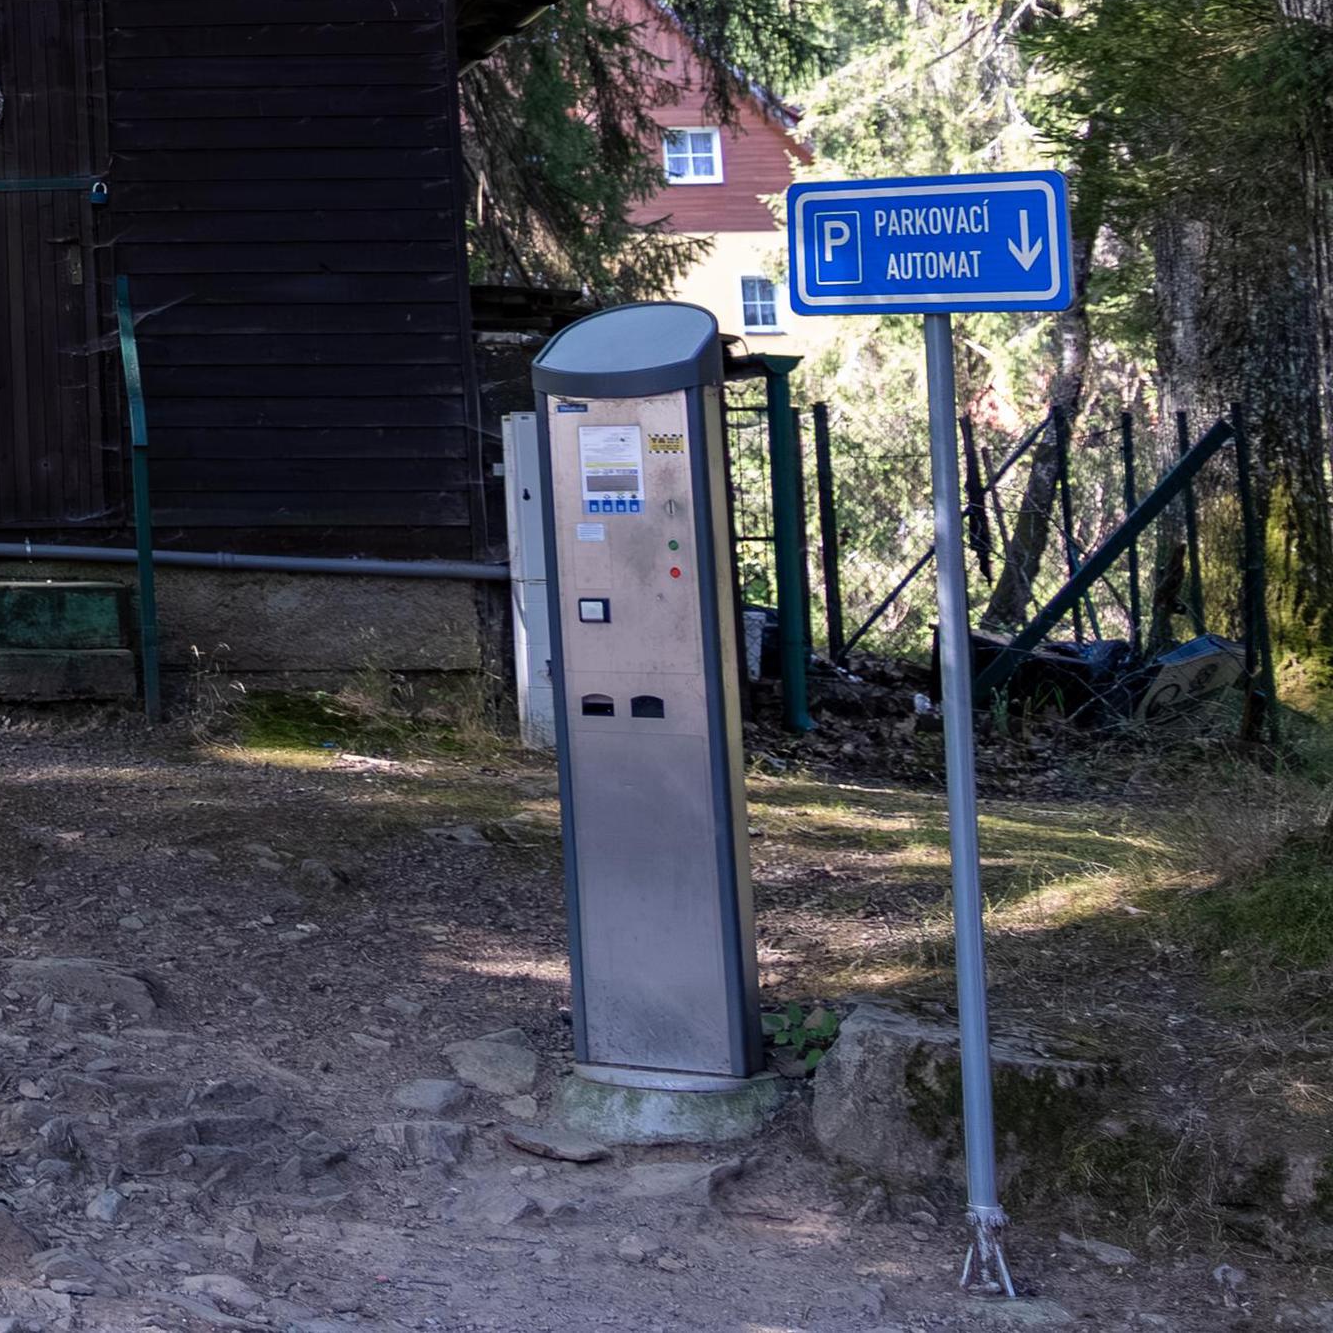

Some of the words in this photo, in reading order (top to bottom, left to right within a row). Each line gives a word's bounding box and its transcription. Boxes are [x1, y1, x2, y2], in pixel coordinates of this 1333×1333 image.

[874, 199, 990, 237] PARKOVACÍ
[823, 220, 851, 262] P
[886, 250, 982, 280] AUTOMAT
